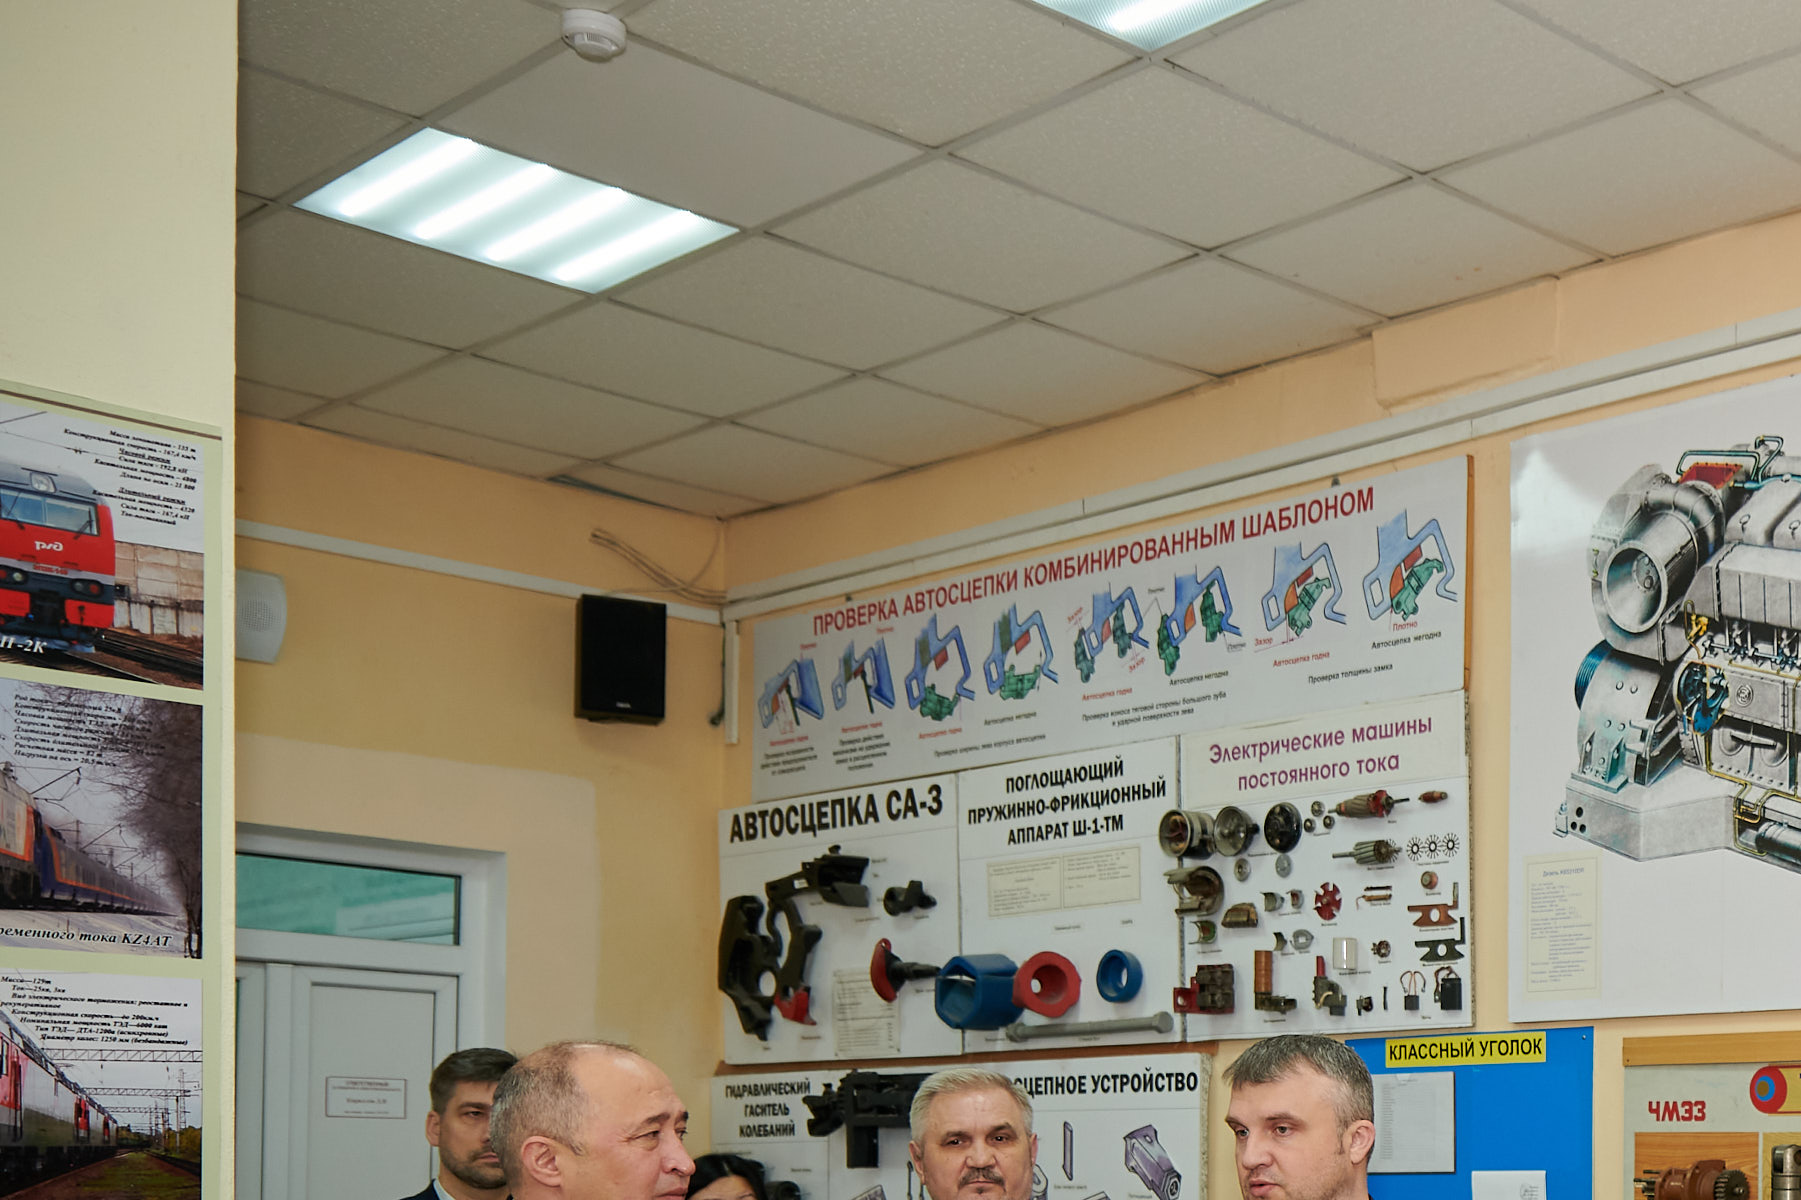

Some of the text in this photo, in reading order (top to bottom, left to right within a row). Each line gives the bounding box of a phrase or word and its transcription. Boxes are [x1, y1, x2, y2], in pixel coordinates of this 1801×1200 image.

[813, 487, 1374, 636] ПРОВЕРКА АВТОСЦЕПКИ КОМБИНИРОВАННЫМ ШАБЛОНОМ
[1393, 621, 1418, 631] Плотно
[1372, 637, 1411, 650] Автосцепка
[1273, 652, 1330, 667] Автосцепка годна
[1308, 672, 1339, 684] Проверка
[1374, 663, 1393, 673] замка
[1209, 717, 1432, 764] Электрические машины
[1005, 756, 1125, 793] ПОГЛОЩАЮЩИЙ
[1238, 754, 1400, 791] постоянного тока
[968, 777, 1167, 825] ПРУЖИННО-ФРИКЦИОННЫЙ
[730, 783, 943, 843] АВТОСЦЕПКА СА-3
[1007, 814, 1124, 846] АППАРАТ Ш-1-ТМ
[79, 933, 117, 943] тока
[121, 932, 172, 947] KZ4AT
[1390, 1038, 1542, 1061] КЛАССНЫЙ УГОЛОК
[725, 1076, 811, 1099] ГИДРАВЛИЧЕСКИЙ
[1014, 1067, 1199, 1098] ЦЕПНОЕ УСТРОЙСТВО
[744, 1102, 790, 1118] ГАСИТЕЛЬ
[739, 1120, 795, 1139] КОЛЕБАНИЙ
